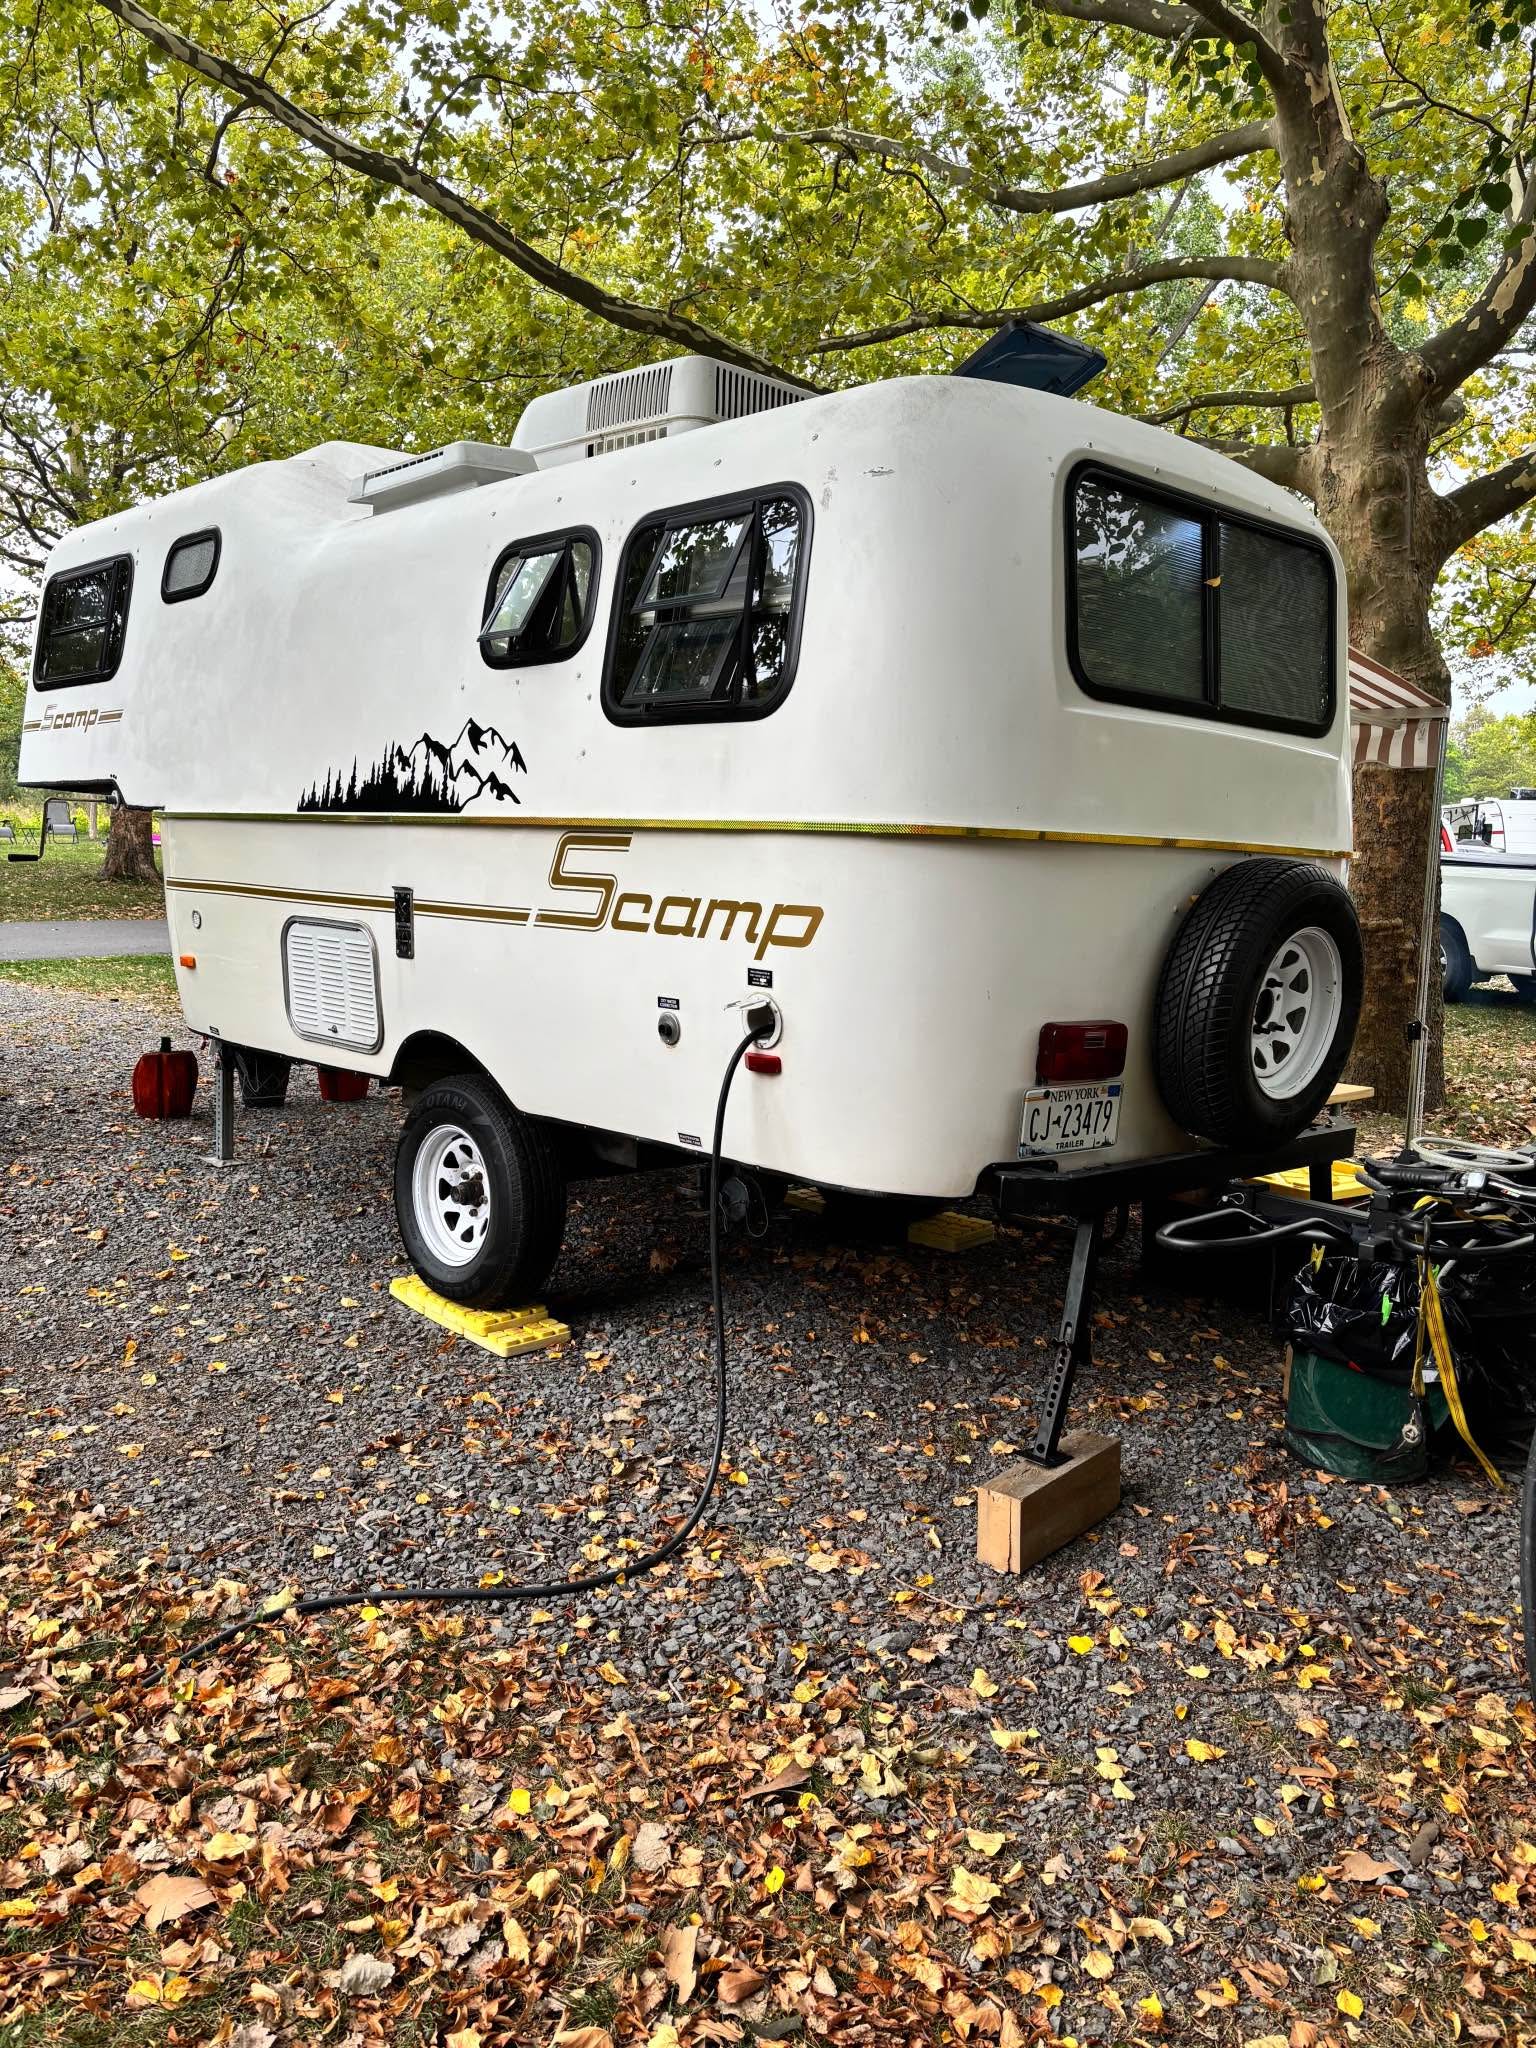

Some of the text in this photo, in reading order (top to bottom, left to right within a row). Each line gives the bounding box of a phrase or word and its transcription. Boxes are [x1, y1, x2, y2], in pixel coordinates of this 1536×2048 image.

[41, 704, 99, 733] Scamp
[533, 830, 825, 961] Scamp
[1050, 1087, 1100, 1103] NEW YORK
[1055, 1139, 1085, 1150] TRAILER
